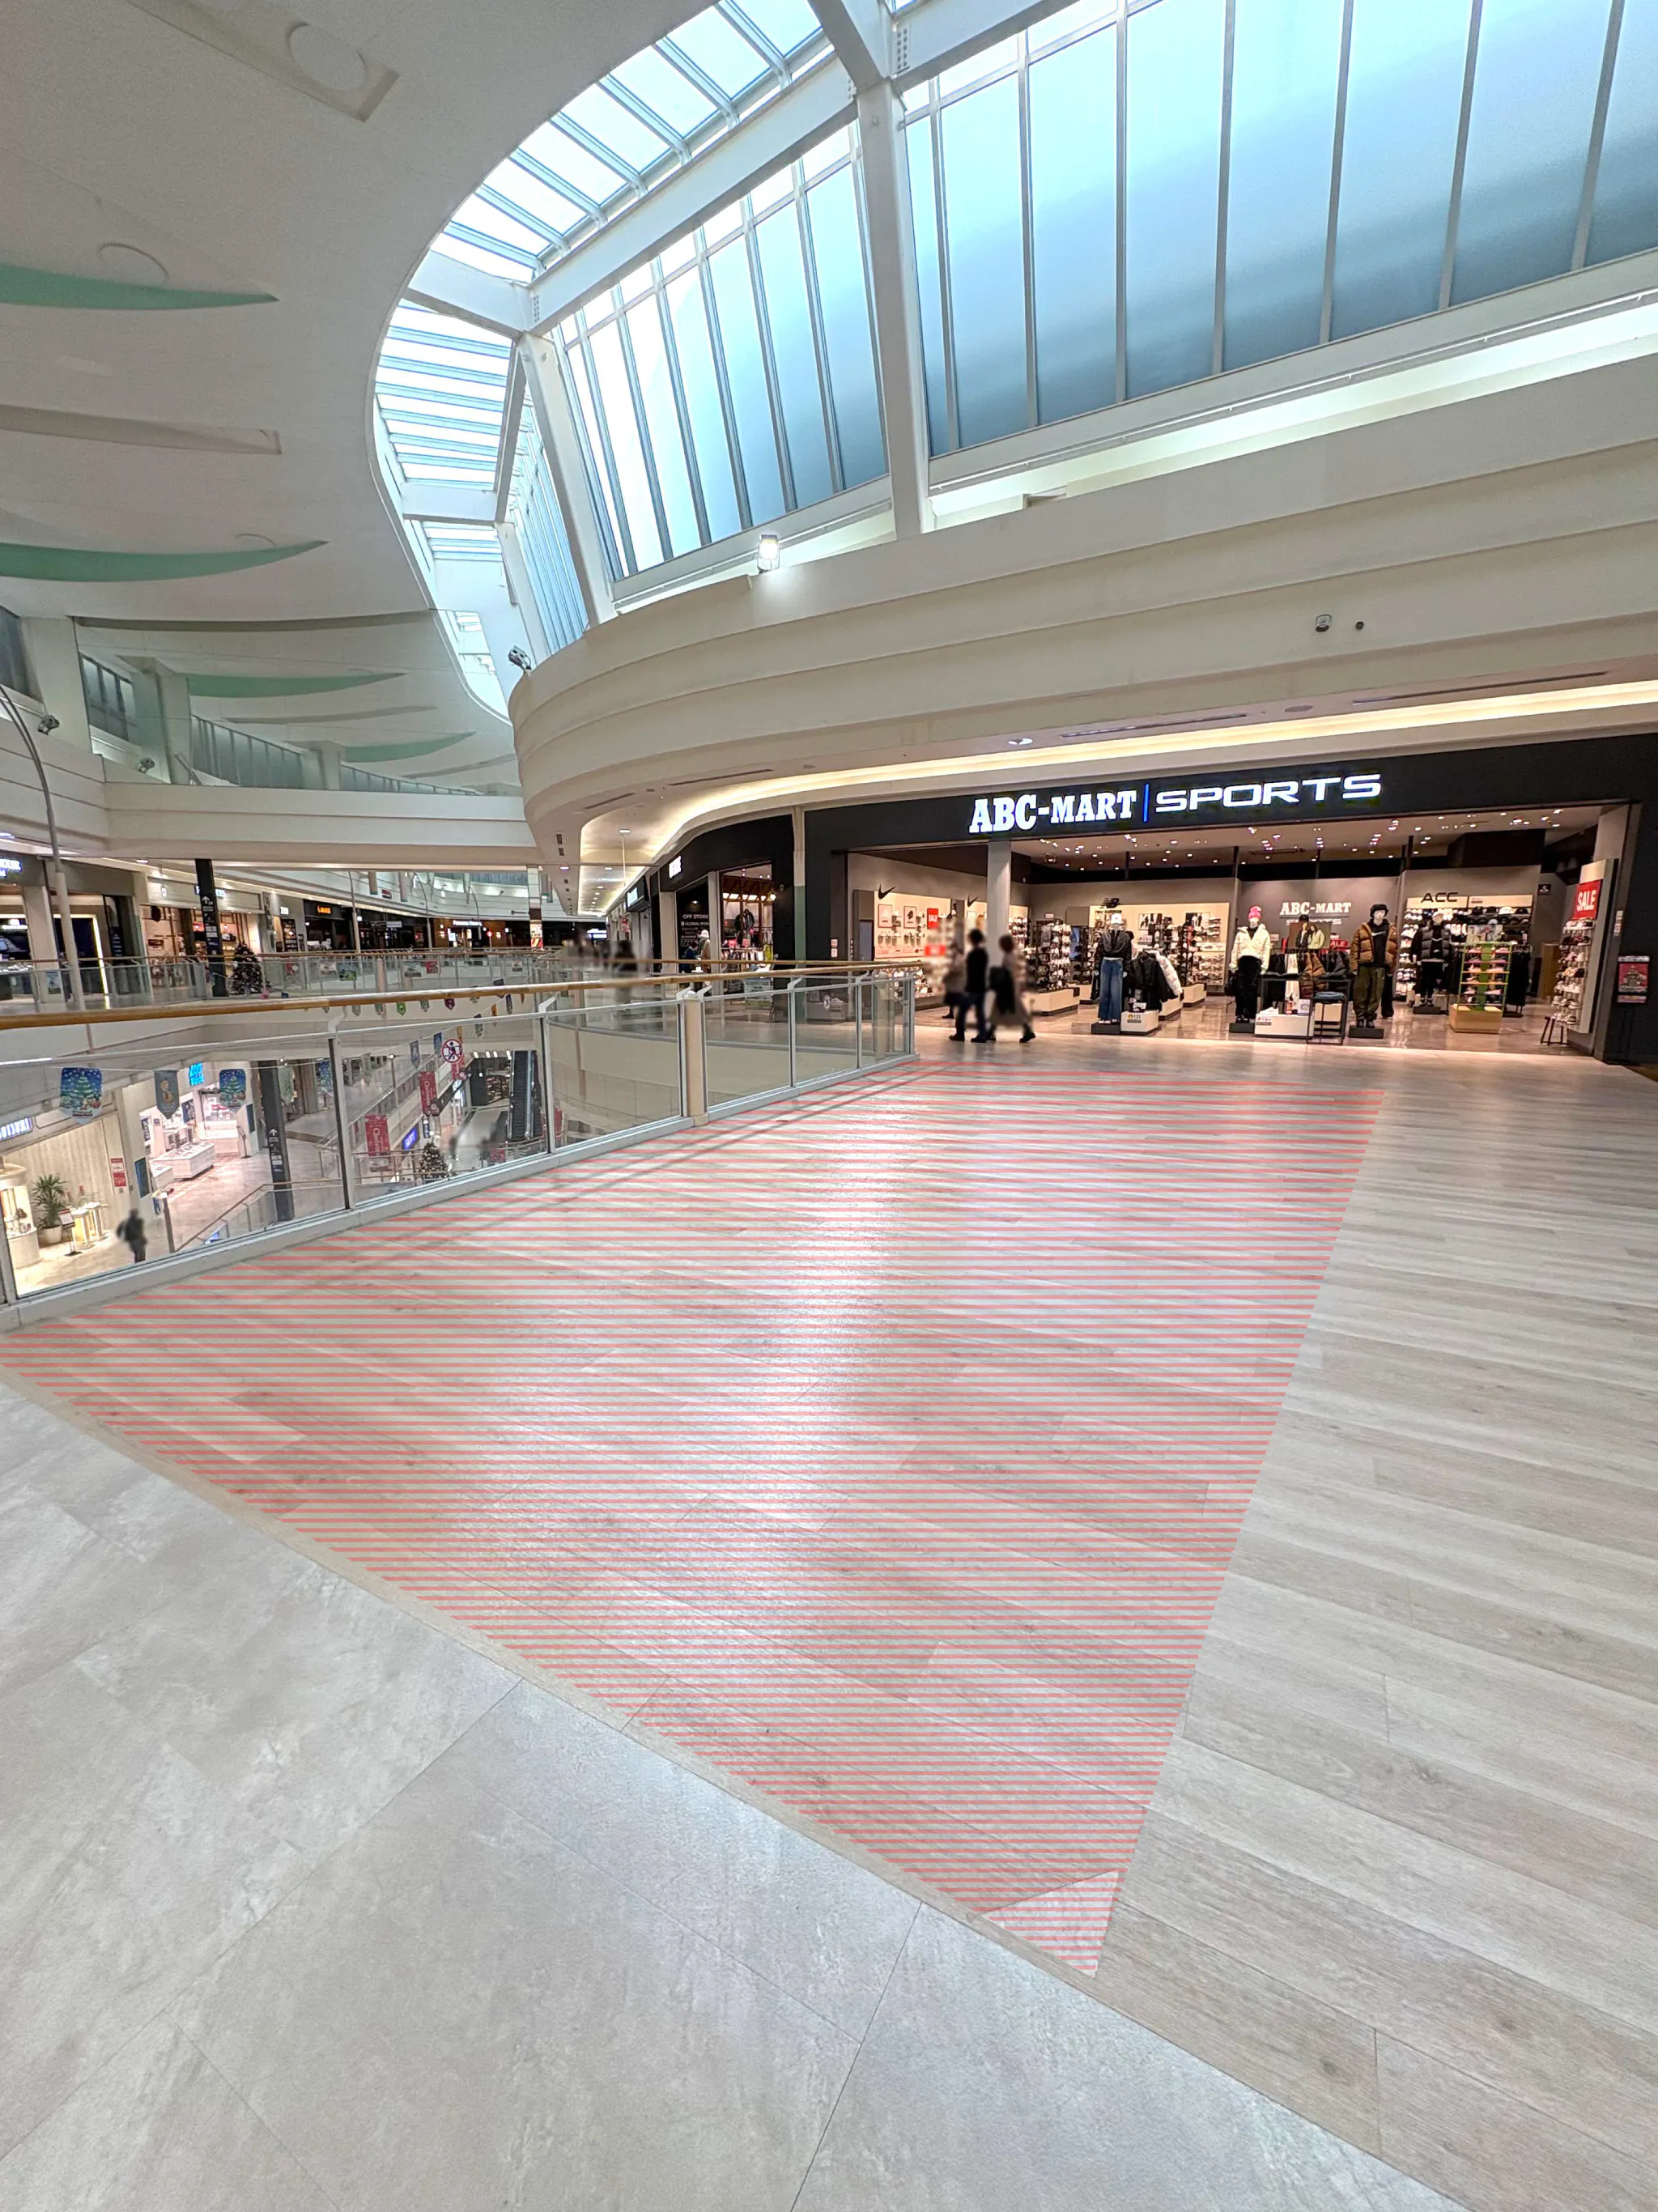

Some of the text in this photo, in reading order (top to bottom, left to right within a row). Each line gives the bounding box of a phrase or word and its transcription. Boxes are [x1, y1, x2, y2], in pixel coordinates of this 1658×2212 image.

[969, 774, 1382, 833] ABC-MART SPORTS
[1421, 892, 1459, 904] ACC
[1576, 889, 1597, 912] SALE
[1279, 901, 1352, 915] ABC-MART
